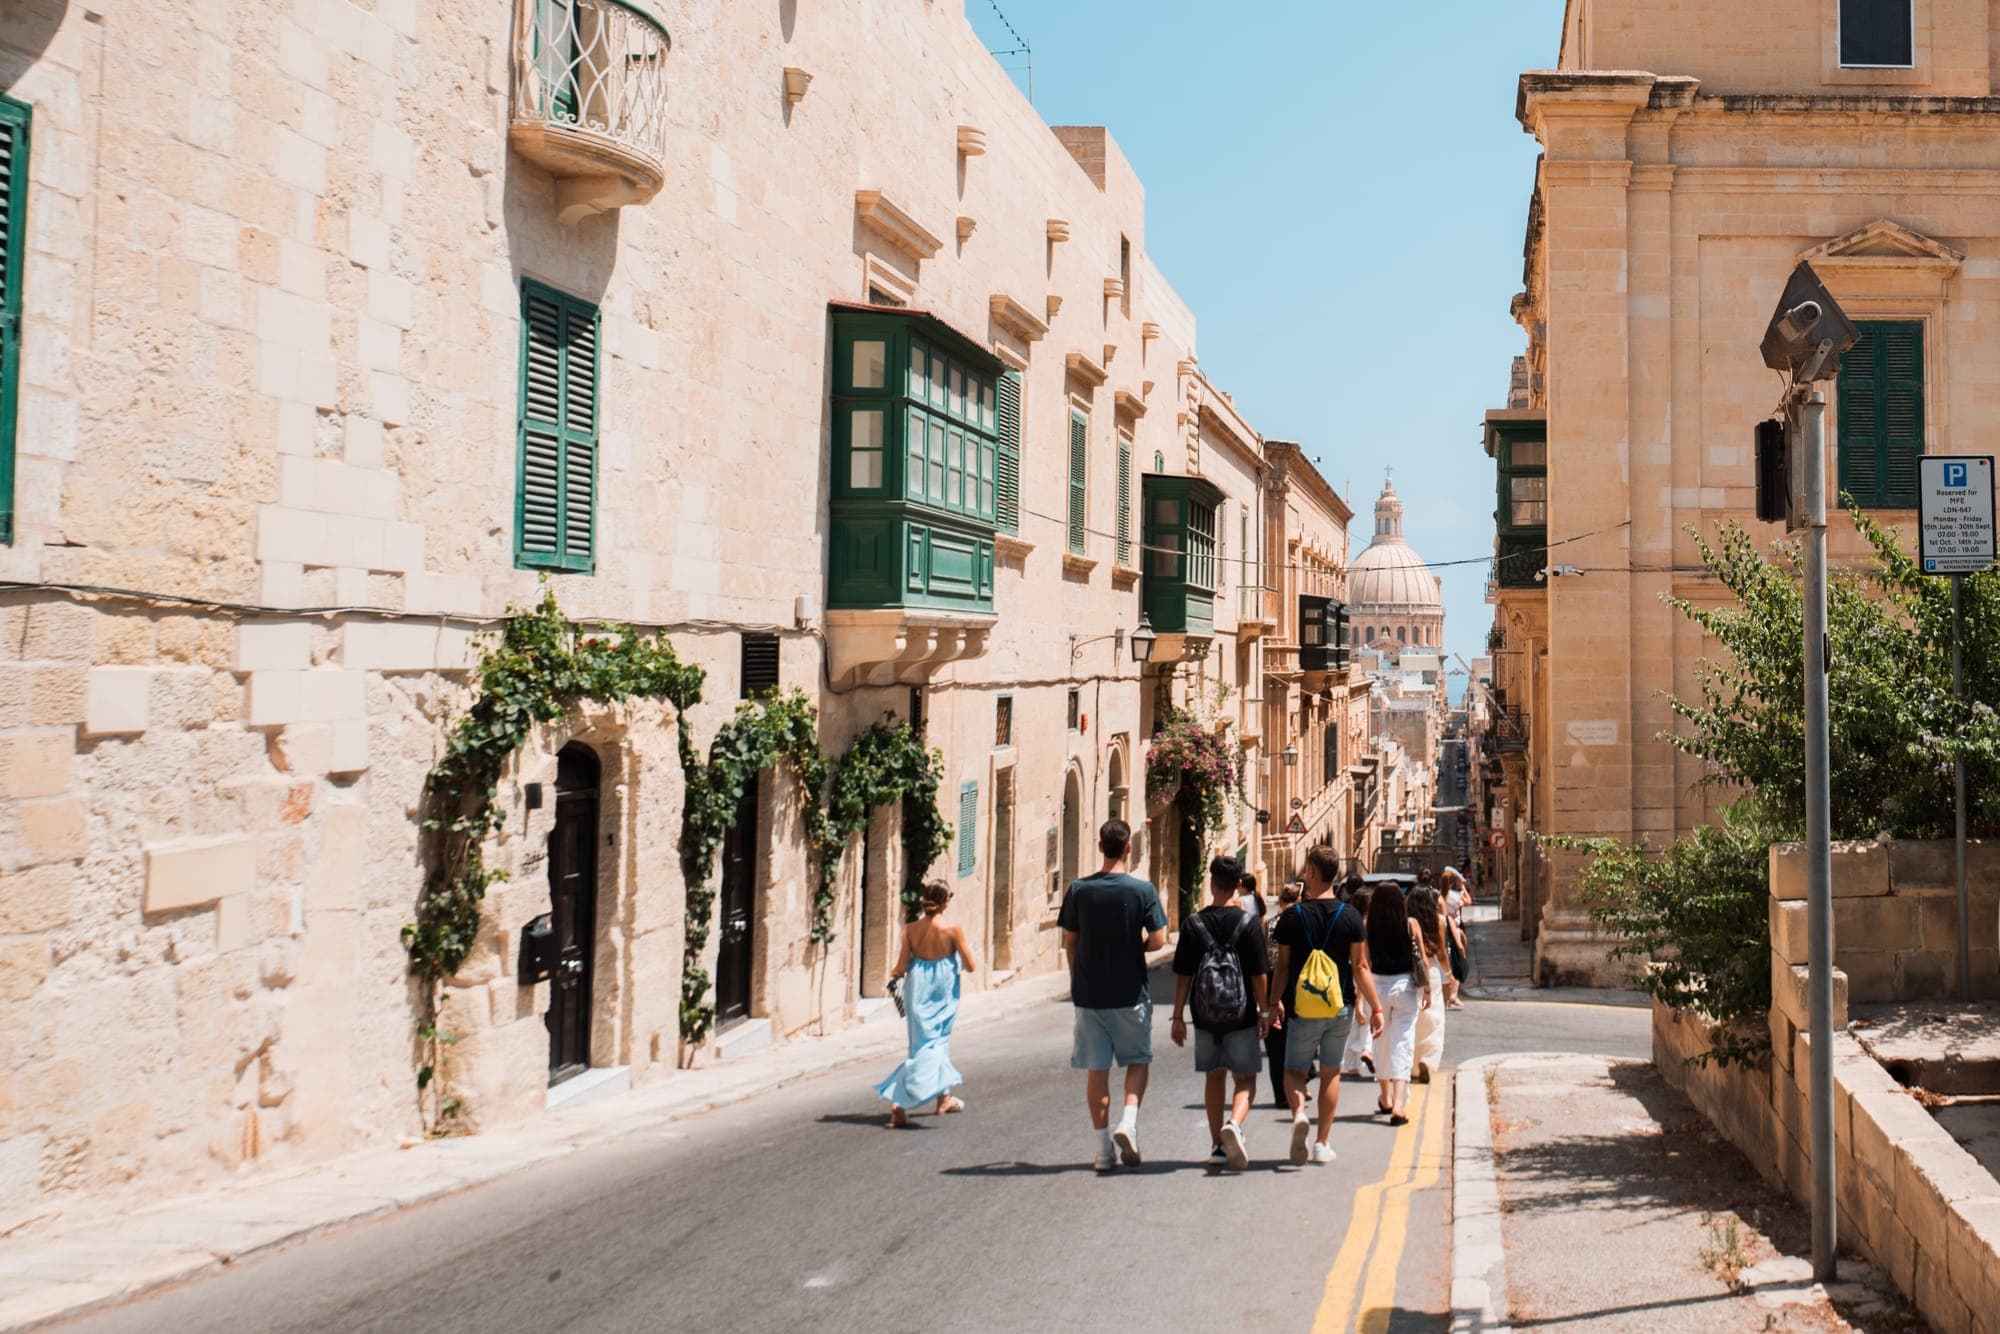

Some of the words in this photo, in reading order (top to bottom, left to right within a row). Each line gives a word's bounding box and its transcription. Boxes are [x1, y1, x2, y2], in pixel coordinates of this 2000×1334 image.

[1949, 465, 1964, 486] P
[1933, 515, 1957, 523] Monday
[1963, 515, 1982, 523] Friday
[1928, 560, 1935, 569] P
